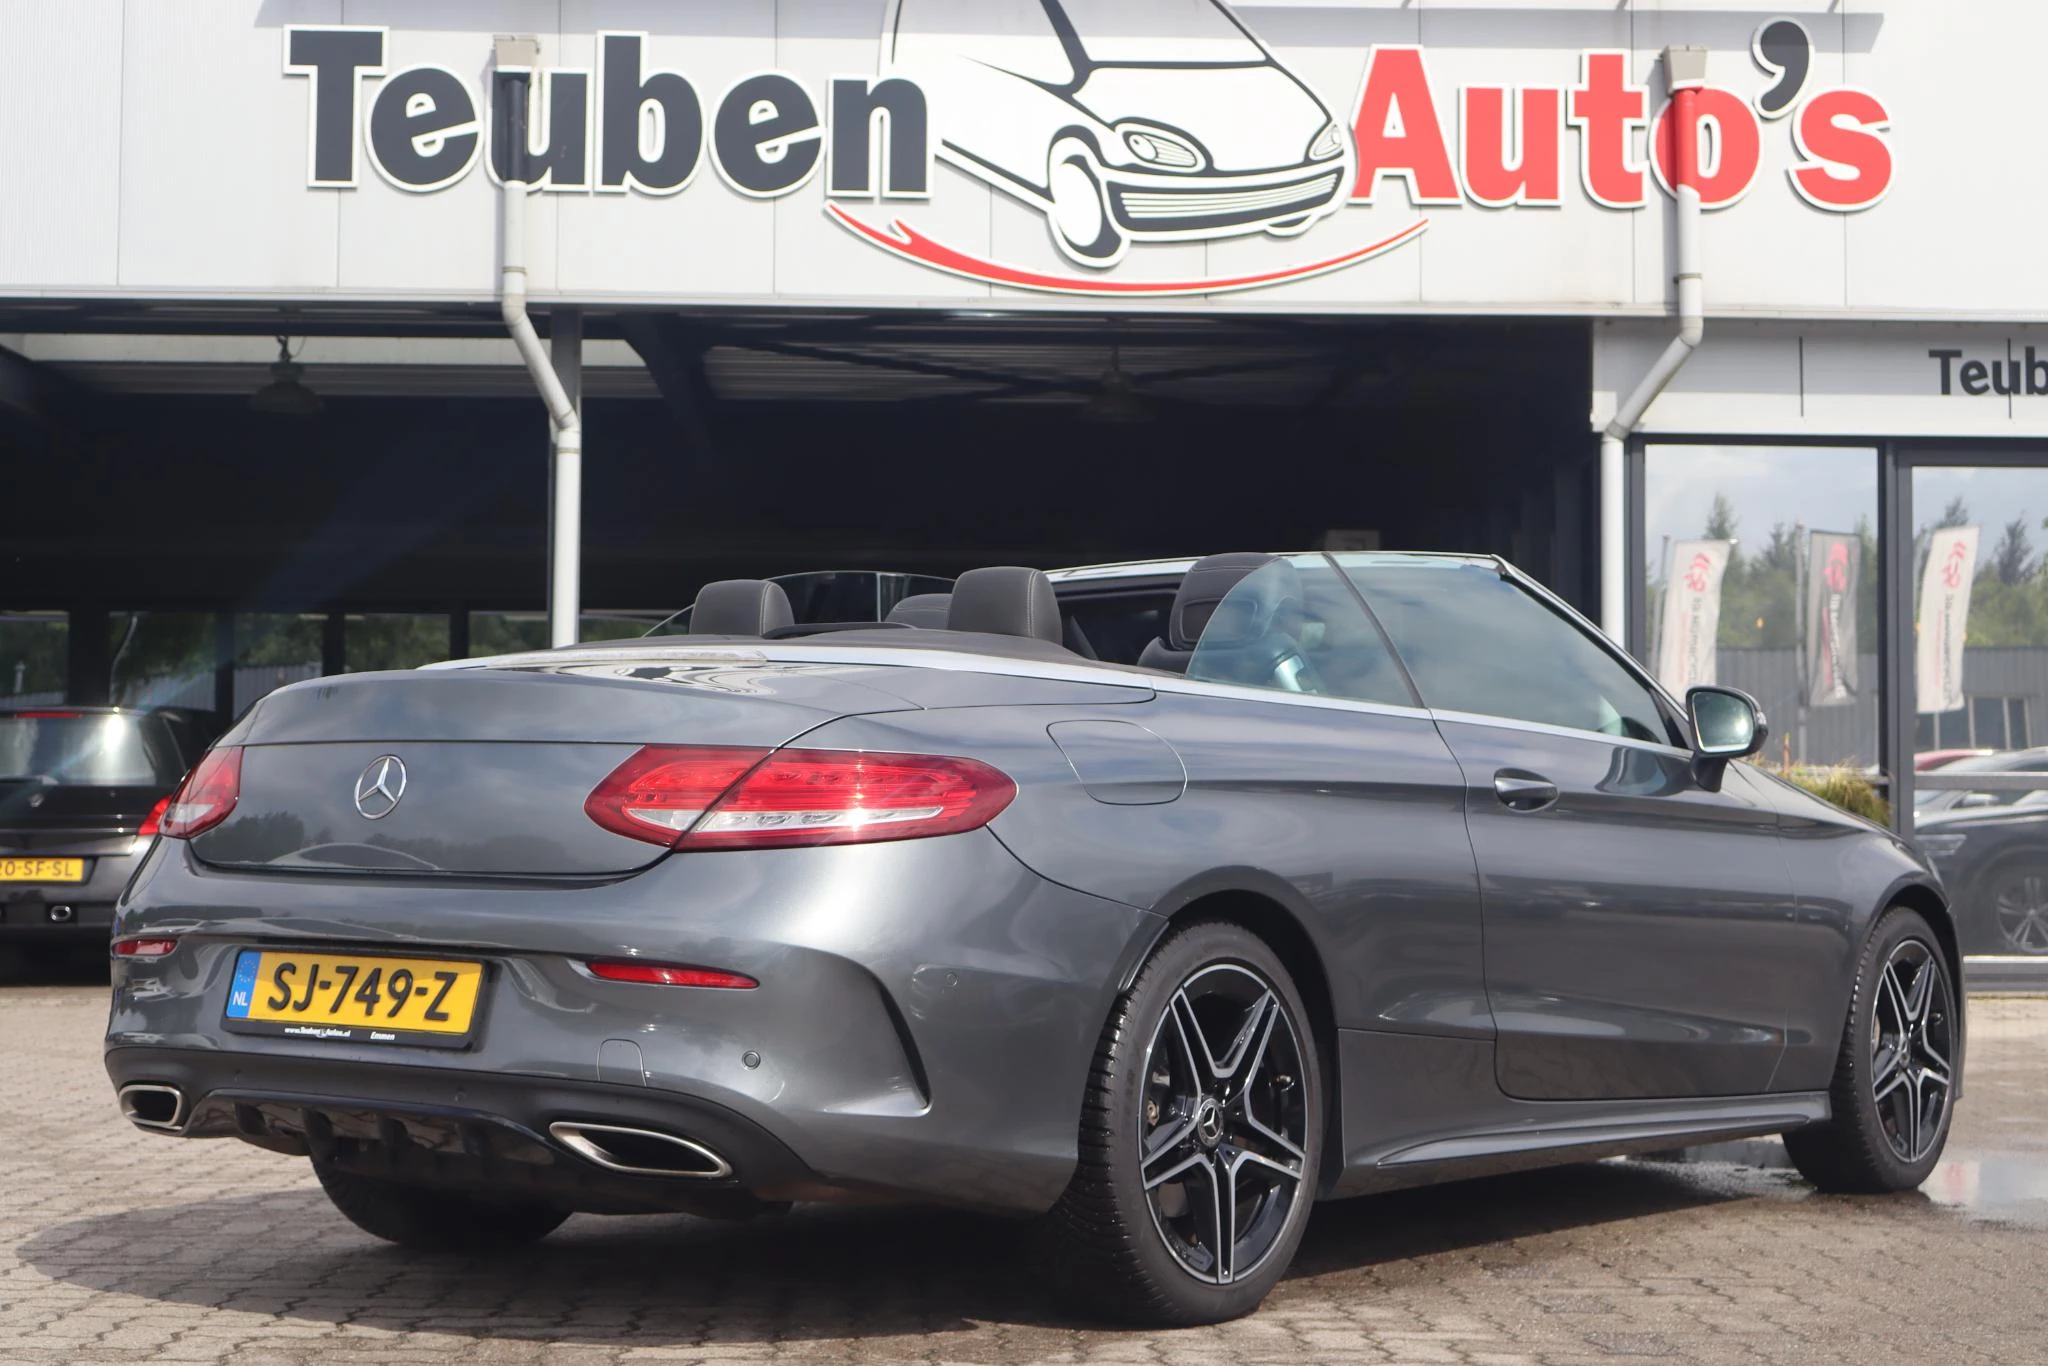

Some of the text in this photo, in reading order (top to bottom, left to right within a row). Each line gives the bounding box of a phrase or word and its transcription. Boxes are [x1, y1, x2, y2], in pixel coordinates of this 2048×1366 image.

[286, 19, 1893, 209] Teuben Auto's
[232, 990, 248, 1007] NL
[267, 962, 458, 1021] SJ-749-Z
[370, 1031, 395, 1040] Emmen
